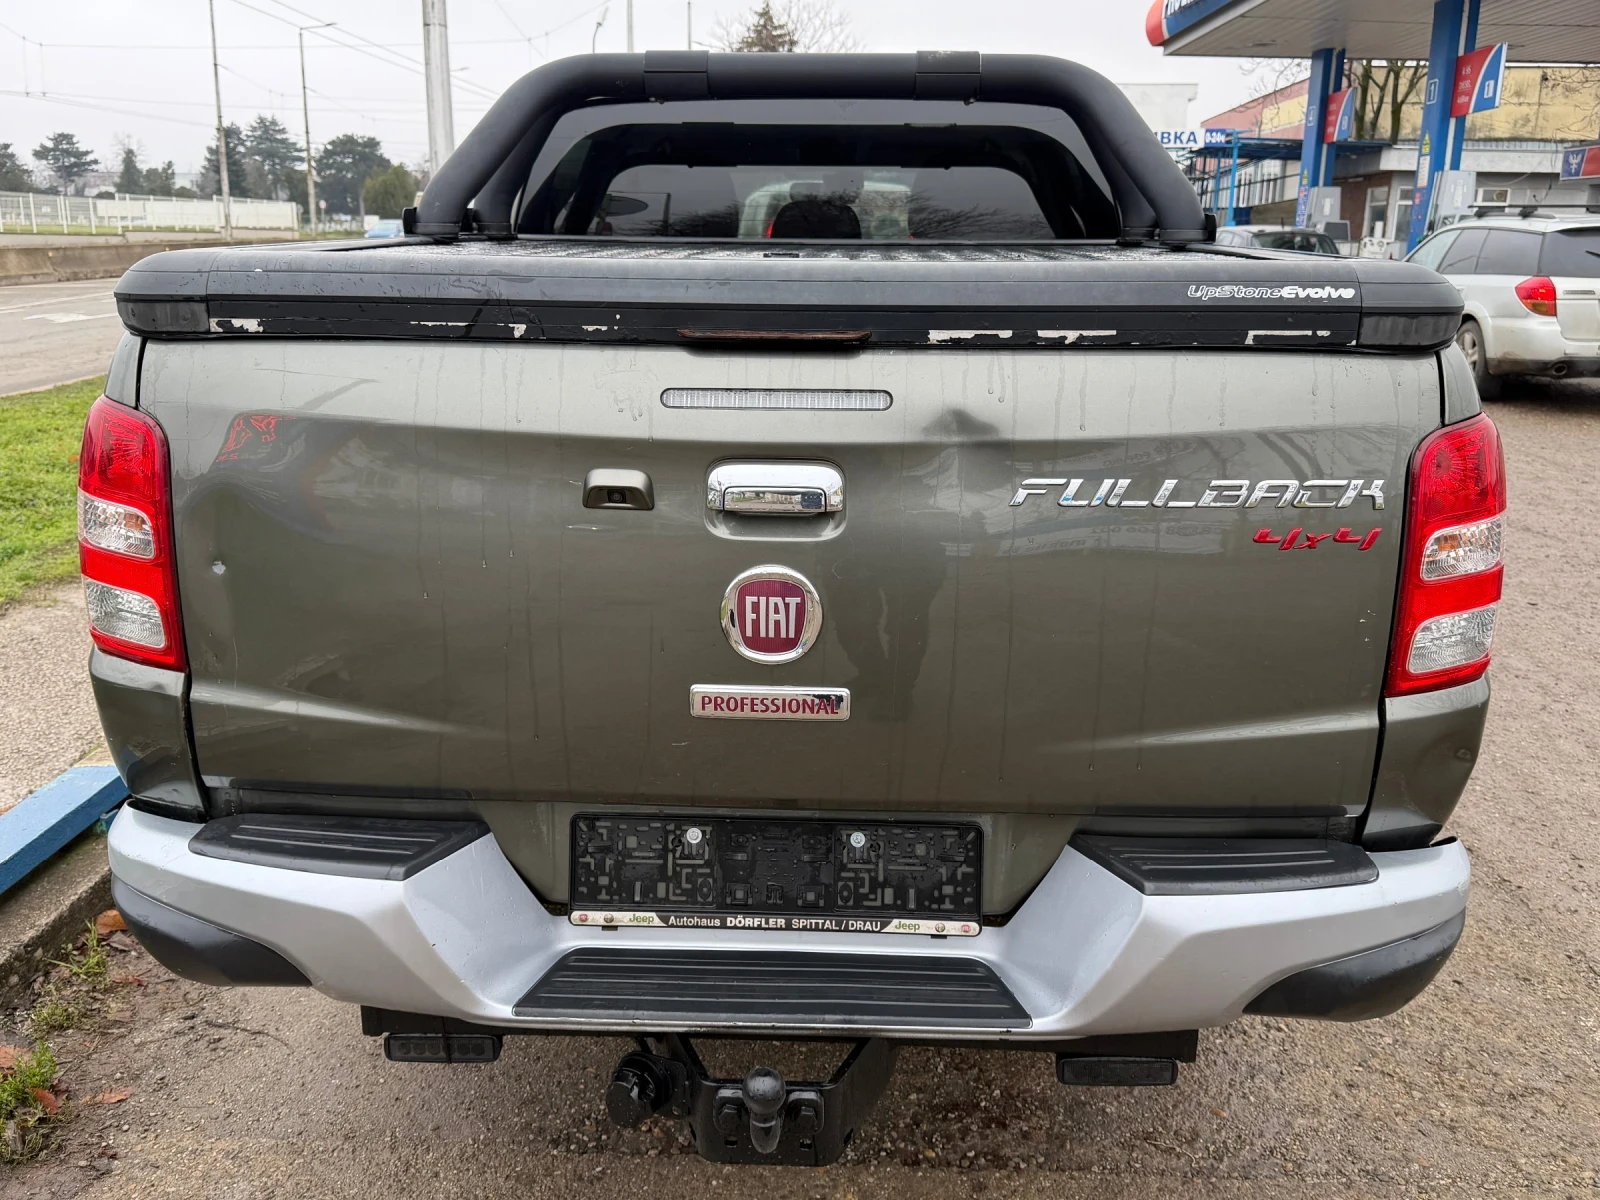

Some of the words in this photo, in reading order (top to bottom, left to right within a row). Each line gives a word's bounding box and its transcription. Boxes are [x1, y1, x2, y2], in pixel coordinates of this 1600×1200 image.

[1154, 131, 1198, 145] ВКА
[1187, 285, 1356, 300] UpStoneEvolve
[1008, 478, 1385, 510] FULLBACK
[1252, 527, 1383, 551] 4x4
[745, 596, 801, 638] FIAT
[701, 695, 839, 715] PROFESSIONAL
[629, 914, 655, 924] Jeep
[668, 915, 721, 927] Autohaus
[726, 915, 786, 929] DÖRFLER
[791, 919, 839, 930] SPITTAL
[848, 921, 881, 932] DRAU
[895, 921, 921, 932] Jeep
